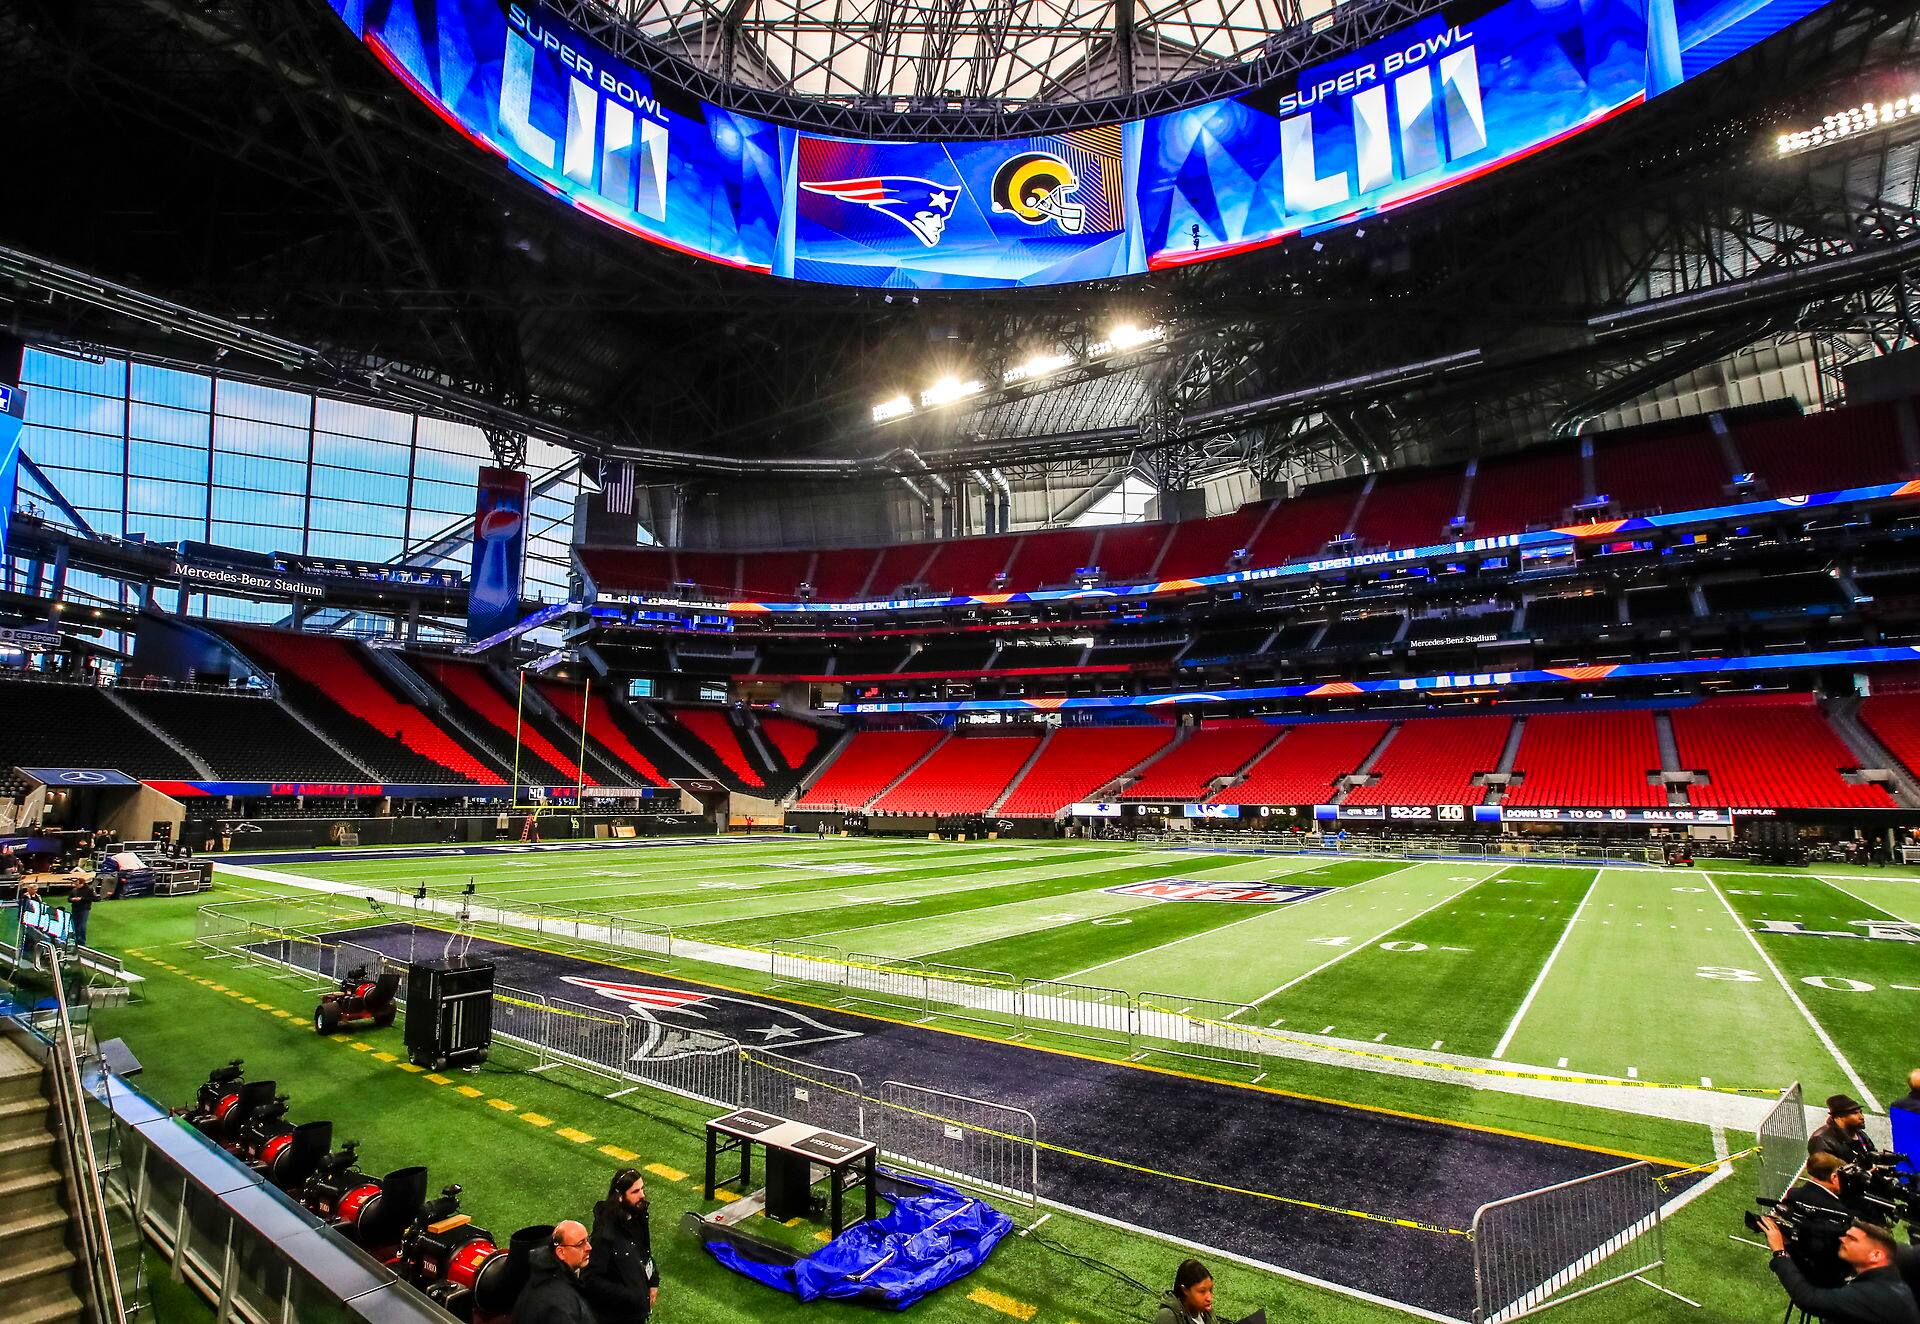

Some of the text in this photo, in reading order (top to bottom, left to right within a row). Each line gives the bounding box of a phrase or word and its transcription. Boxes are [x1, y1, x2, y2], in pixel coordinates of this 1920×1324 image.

[508, 3, 670, 122] SUPER BOWL
[1279, 25, 1473, 115] SUPER BOWL
[1308, 558, 1353, 572] SUPER
[1354, 553, 1393, 567] BOWL
[174, 563, 323, 596] Mercedes-Benz Stadium
[830, 603, 864, 612] SUPER
[866, 602, 892, 610] BOWL
[16, 632, 59, 644] CBS SPORTS
[1410, 634, 1497, 648] Mercedes-Benz Stadium
[1163, 806, 1170, 815] 3
[1289, 807, 1297, 816] 3
[1390, 806, 1432, 819] 52:22
[1440, 806, 1462, 819] 40
[1506, 808, 1719, 821] DOWN 1ST TO GO 10 BALL ON 25
[1128, 884, 1279, 902] NFL
[733, 1115, 769, 1129] VISITORS
[809, 1138, 849, 1153] VISITORS
[1366, 1213, 1398, 1224] CAUTION
[1417, 1222, 1450, 1234] CAUTION
